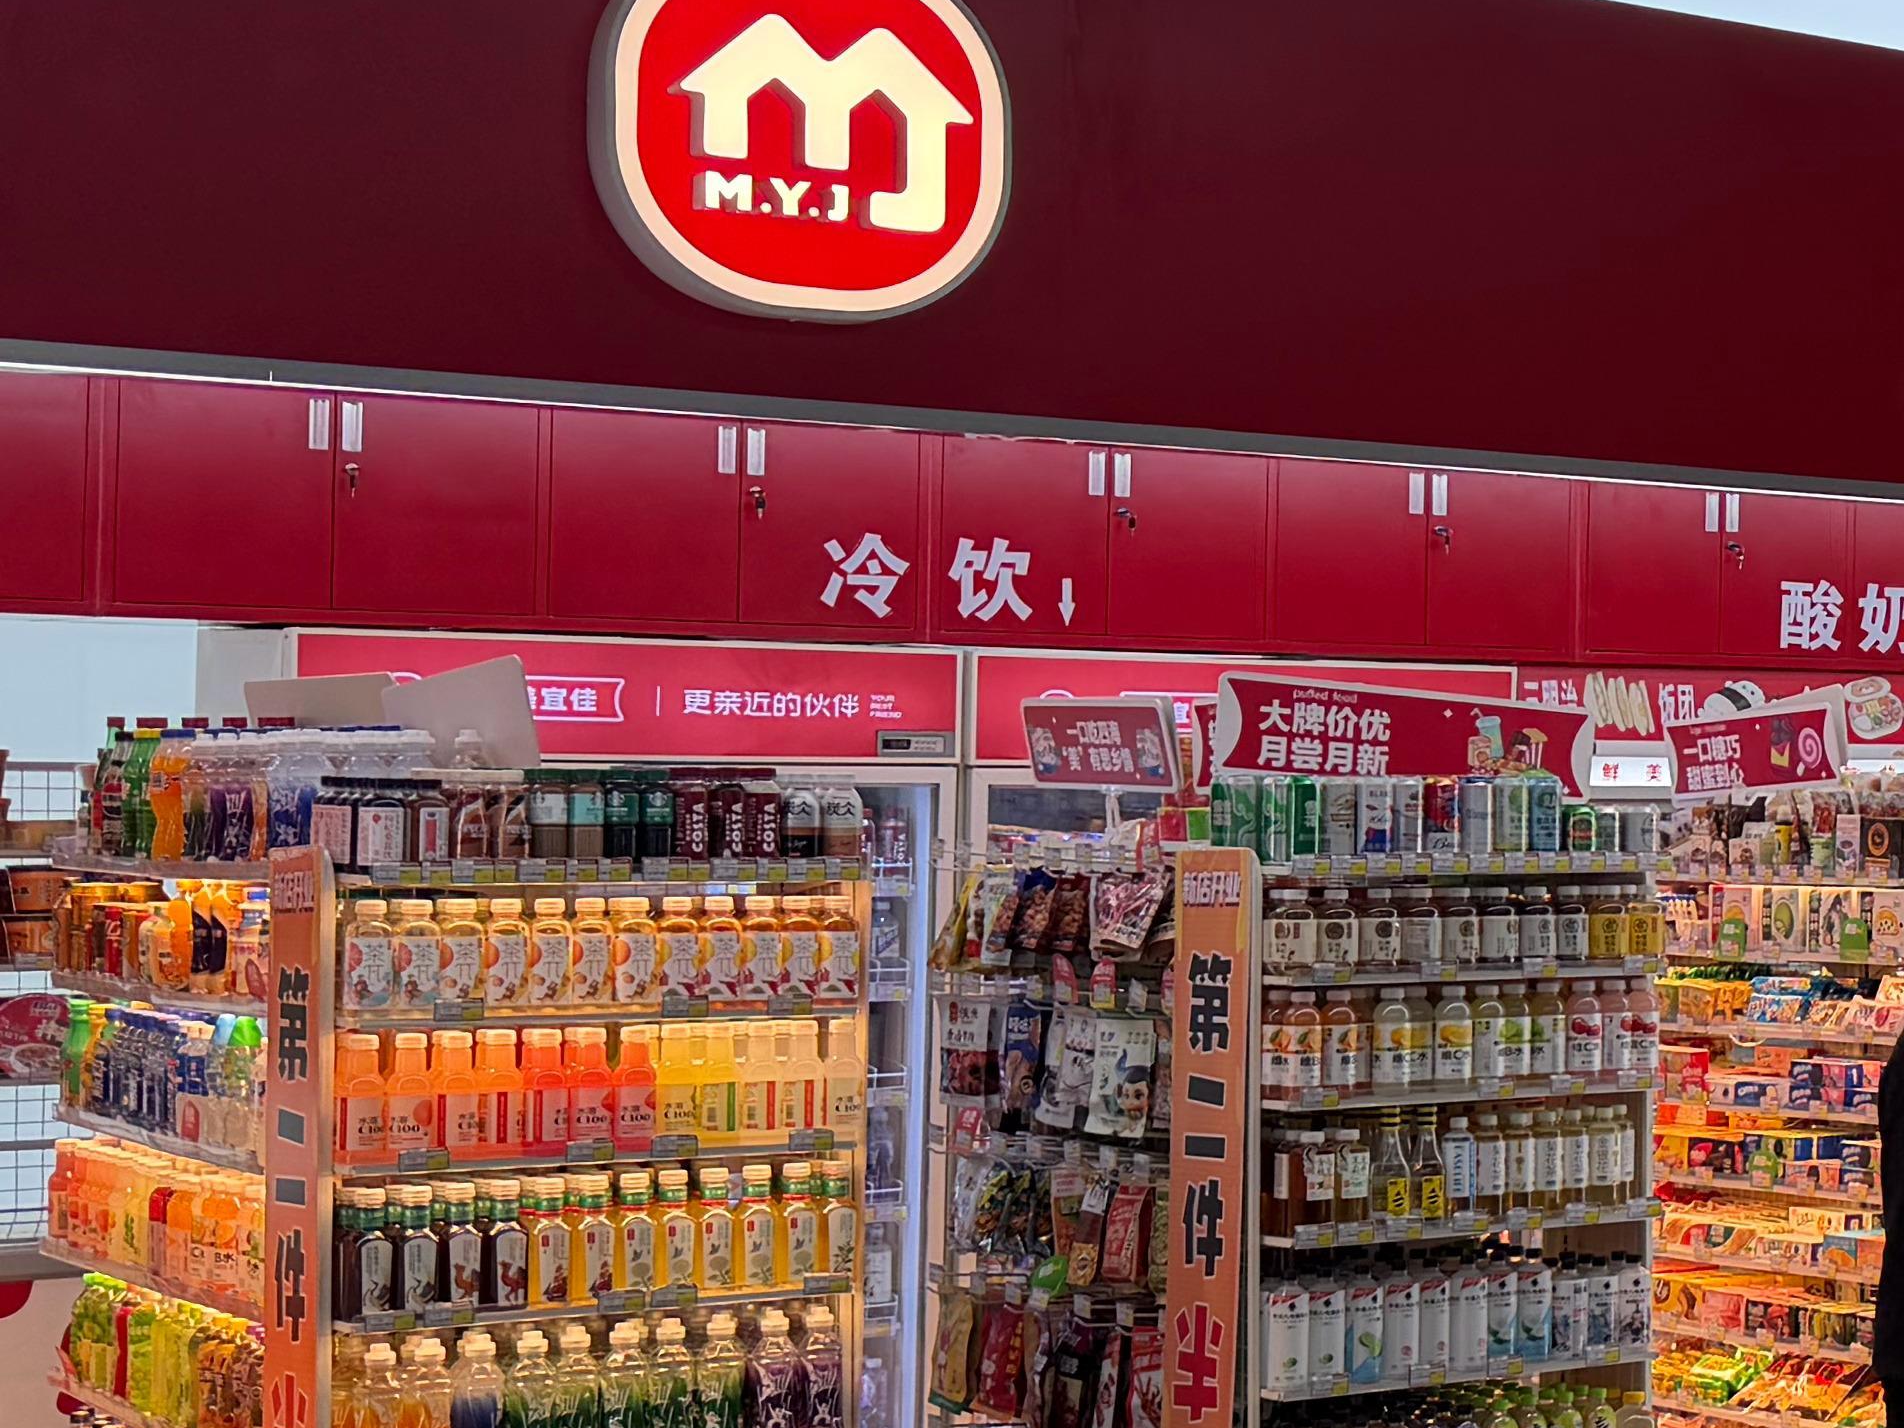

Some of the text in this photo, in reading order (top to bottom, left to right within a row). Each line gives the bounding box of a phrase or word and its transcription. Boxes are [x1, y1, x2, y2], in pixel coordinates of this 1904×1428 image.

[820, 532, 1034, 622] 冷饮
[682, 688, 861, 718] 更亲近的伙伴
[1258, 696, 1391, 742] 大牌价优
[1256, 734, 1389, 776] 月尝月新
[692, 802, 705, 853] COSTA
[731, 802, 743, 853] COSTA
[763, 802, 776, 853] COSTA
